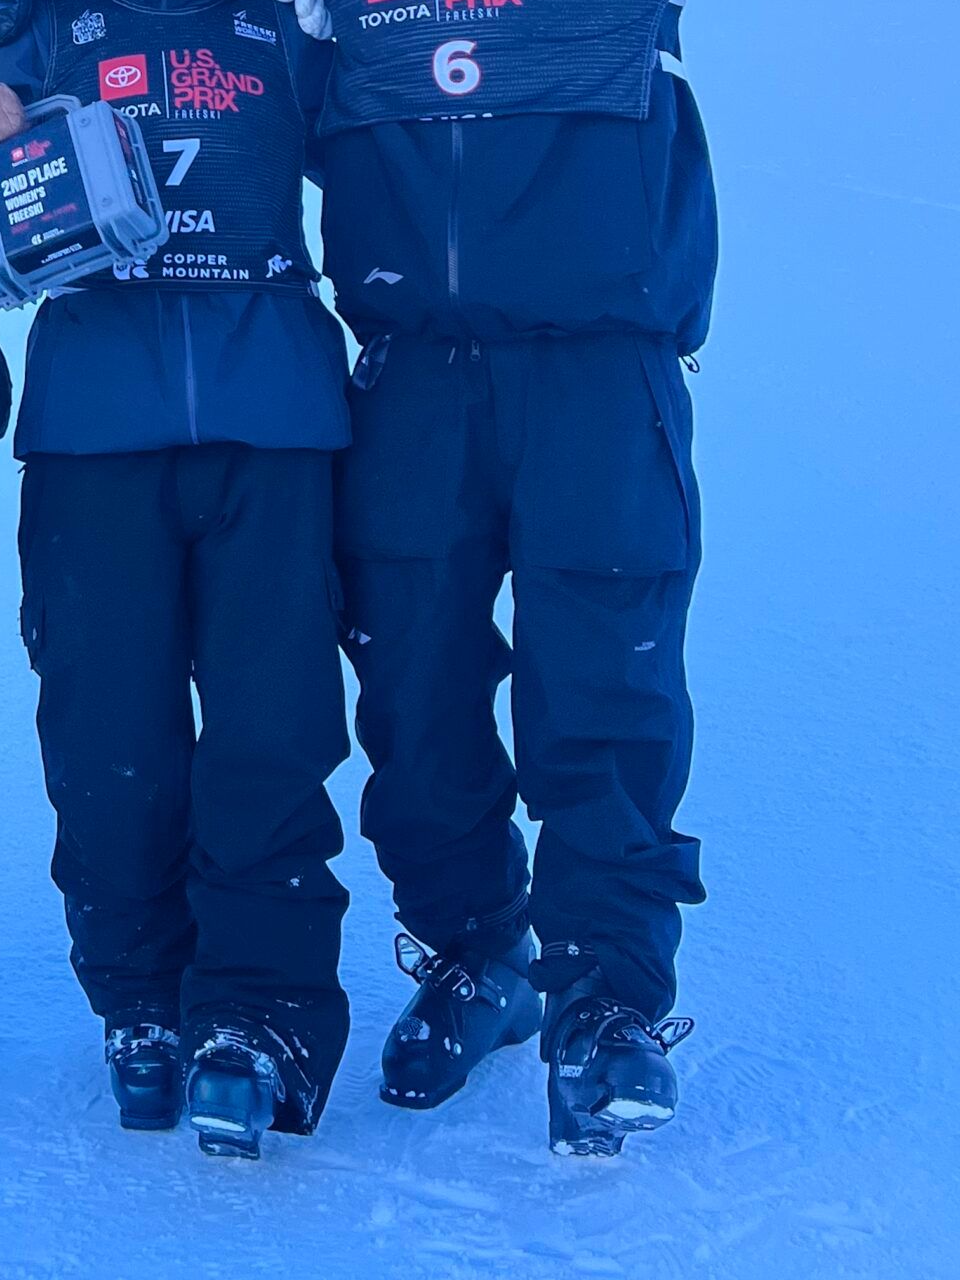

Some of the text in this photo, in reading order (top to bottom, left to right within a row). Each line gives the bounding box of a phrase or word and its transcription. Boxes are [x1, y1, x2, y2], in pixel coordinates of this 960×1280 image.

[358, 3, 431, 30] TOYOTA
[446, 7, 499, 21] FREESKI
[169, 48, 221, 70] U.S.
[432, 39, 481, 97] 6
[170, 67, 264, 96] GRAND
[174, 86, 240, 113] PRIX
[175, 108, 221, 120] FREESKI
[162, 138, 201, 187] 7
[1, 156, 69, 197] 2ND PLACE
[4, 185, 46, 211] WOMEN'S
[7, 201, 45, 226] FREESKI
[162, 253, 228, 266] COPPER
[161, 266, 250, 280] MOUNTAIN
